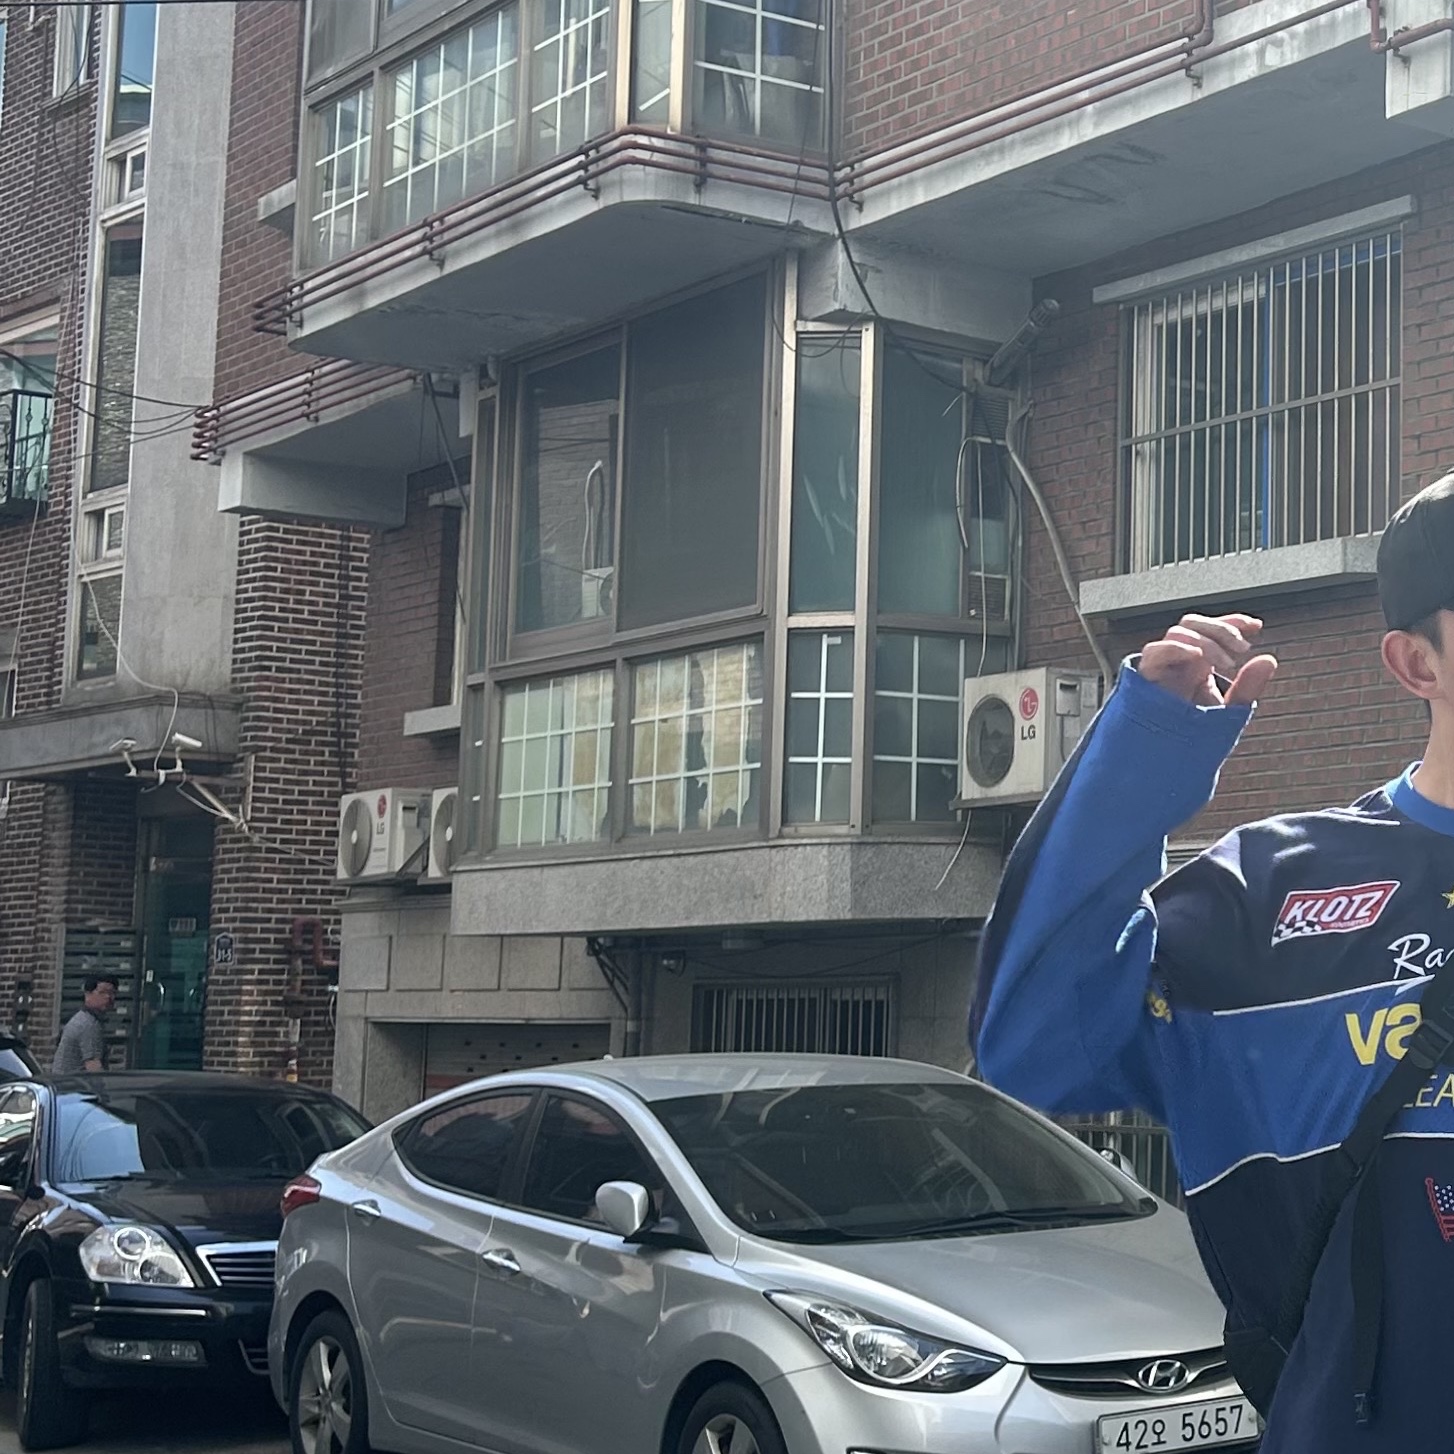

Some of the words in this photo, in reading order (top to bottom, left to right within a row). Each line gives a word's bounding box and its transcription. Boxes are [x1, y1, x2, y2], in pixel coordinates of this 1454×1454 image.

[1020, 724, 1037, 741] LG
[1284, 890, 1385, 924] KLOTZ
[1116, 1418, 1168, 1452] 42오
[1181, 1403, 1244, 1443] 5657
